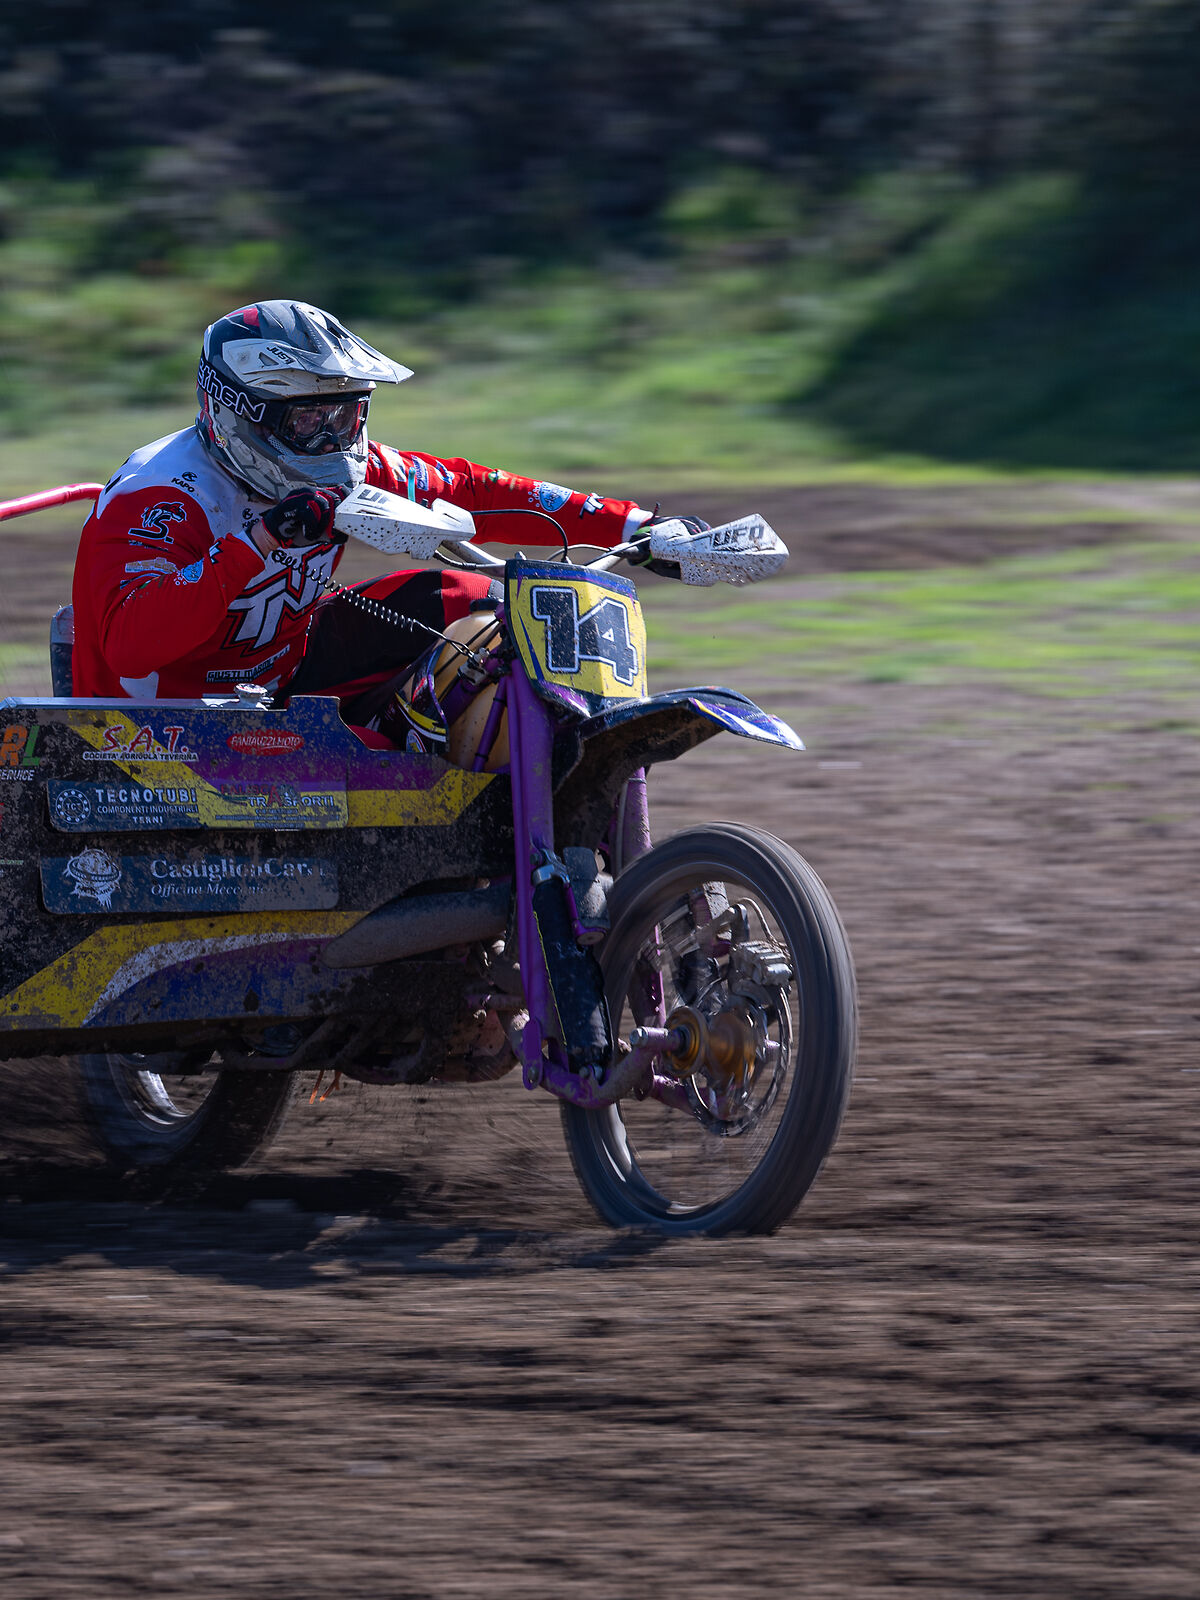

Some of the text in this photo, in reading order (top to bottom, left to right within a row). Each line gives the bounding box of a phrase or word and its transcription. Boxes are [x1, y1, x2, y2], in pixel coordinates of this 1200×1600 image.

[171, 477, 195, 493] KAPO
[712, 525, 765, 547] UFO
[530, 586, 639, 686] 14
[100, 724, 190, 753] S.A.T.
[94, 787, 198, 804] TECNOTUBI
[132, 815, 164, 825] TERNI
